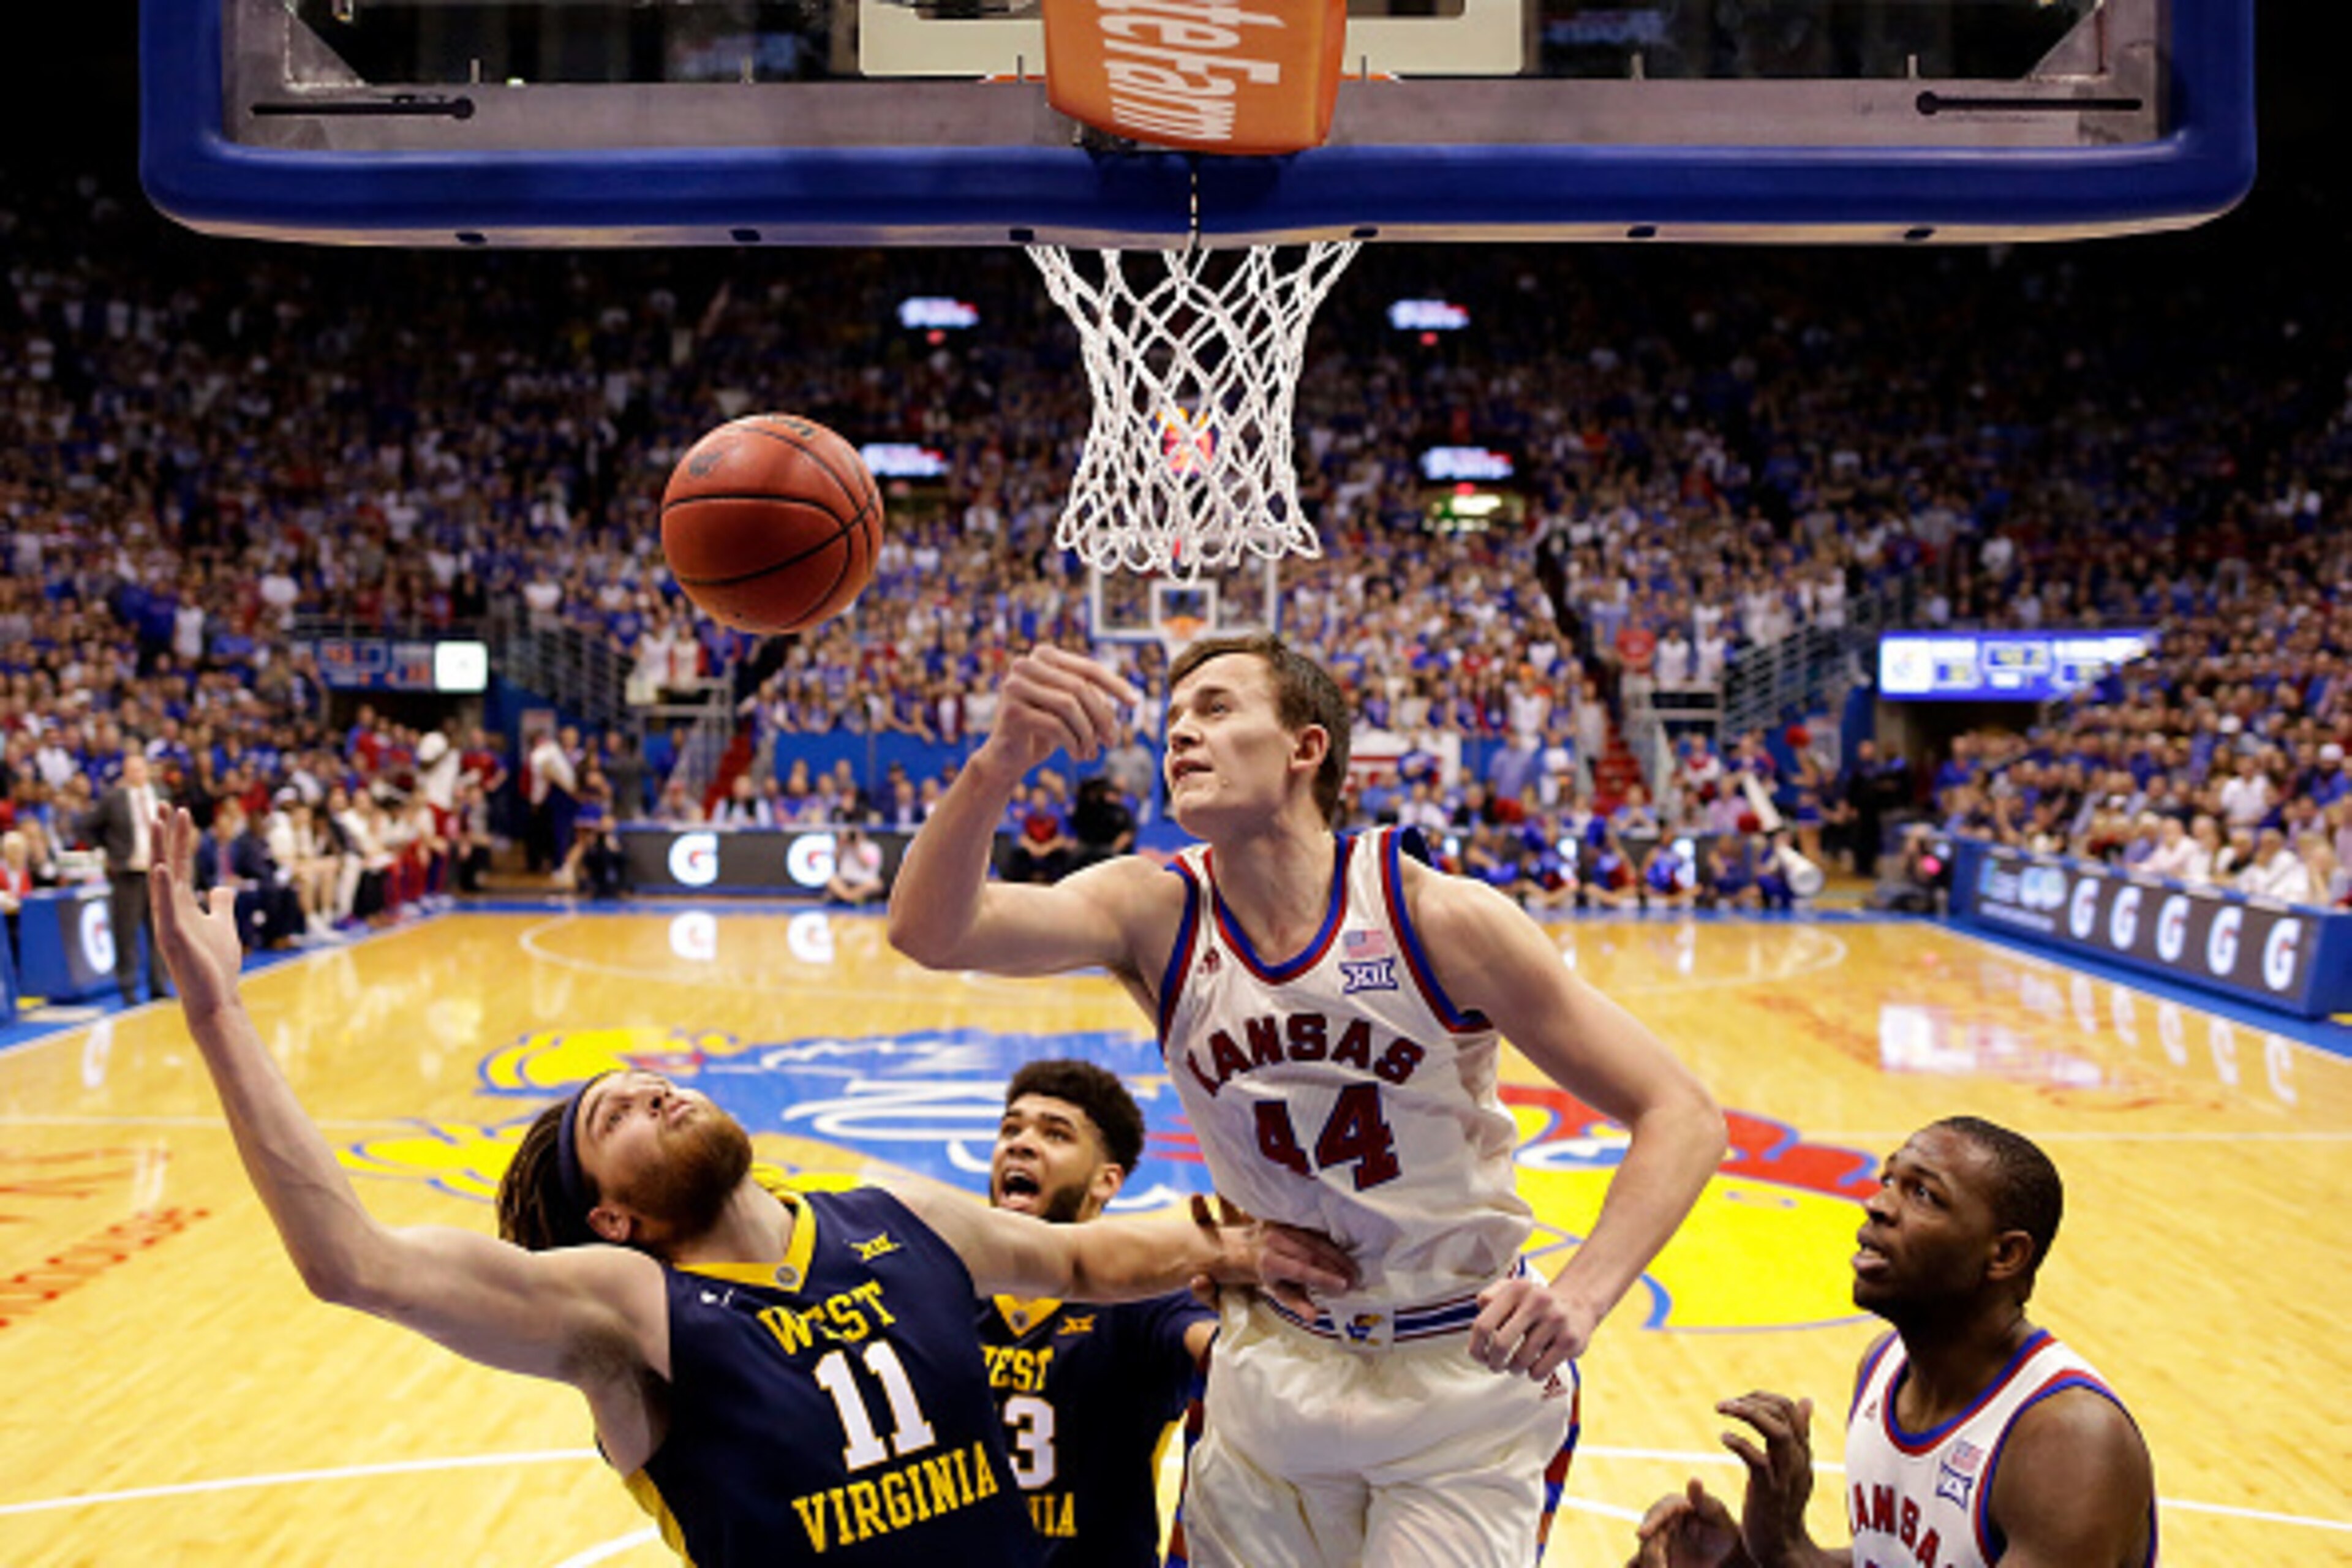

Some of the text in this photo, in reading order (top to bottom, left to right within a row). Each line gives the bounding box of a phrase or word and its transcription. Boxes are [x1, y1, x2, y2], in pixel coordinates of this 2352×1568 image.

[668, 832, 836, 888] G G
[80, 898, 116, 974] G
[2070, 878, 2100, 939] G
[2109, 886, 2142, 950] G
[2155, 894, 2190, 962] G
[2208, 906, 2244, 976] G
[2263, 918, 2302, 991] G
[1254, 1082, 1402, 1193] 44
[813, 1338, 937, 1471] 11
[792, 1441, 998, 1553] VIRGINIA
